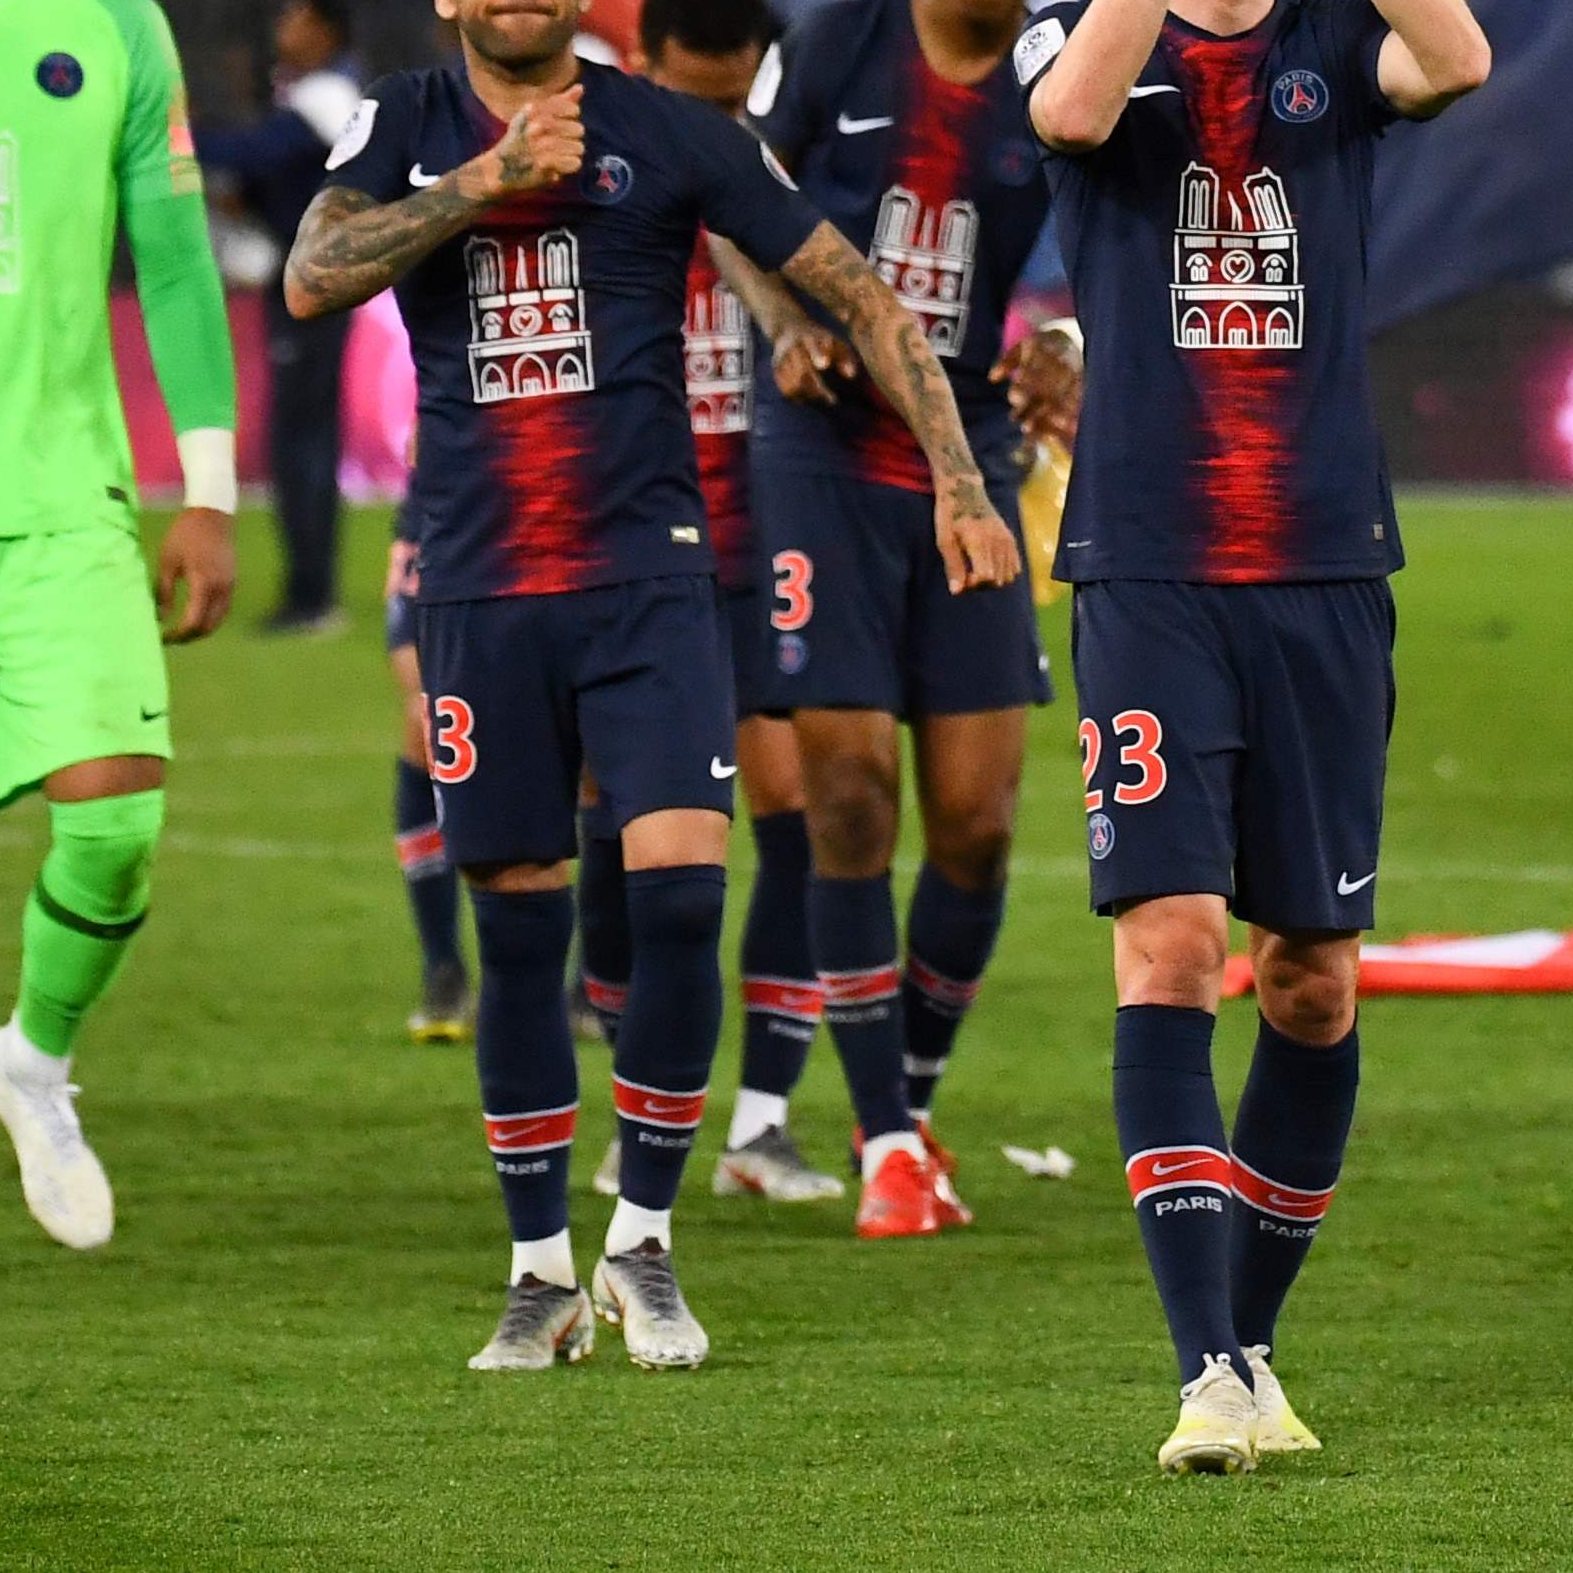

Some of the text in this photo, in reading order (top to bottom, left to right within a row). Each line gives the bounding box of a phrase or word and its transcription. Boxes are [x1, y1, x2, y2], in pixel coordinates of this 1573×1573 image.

[769, 548, 815, 632] 3
[1078, 709, 1168, 813] 23
[1154, 1195, 1224, 1217] PARIS
